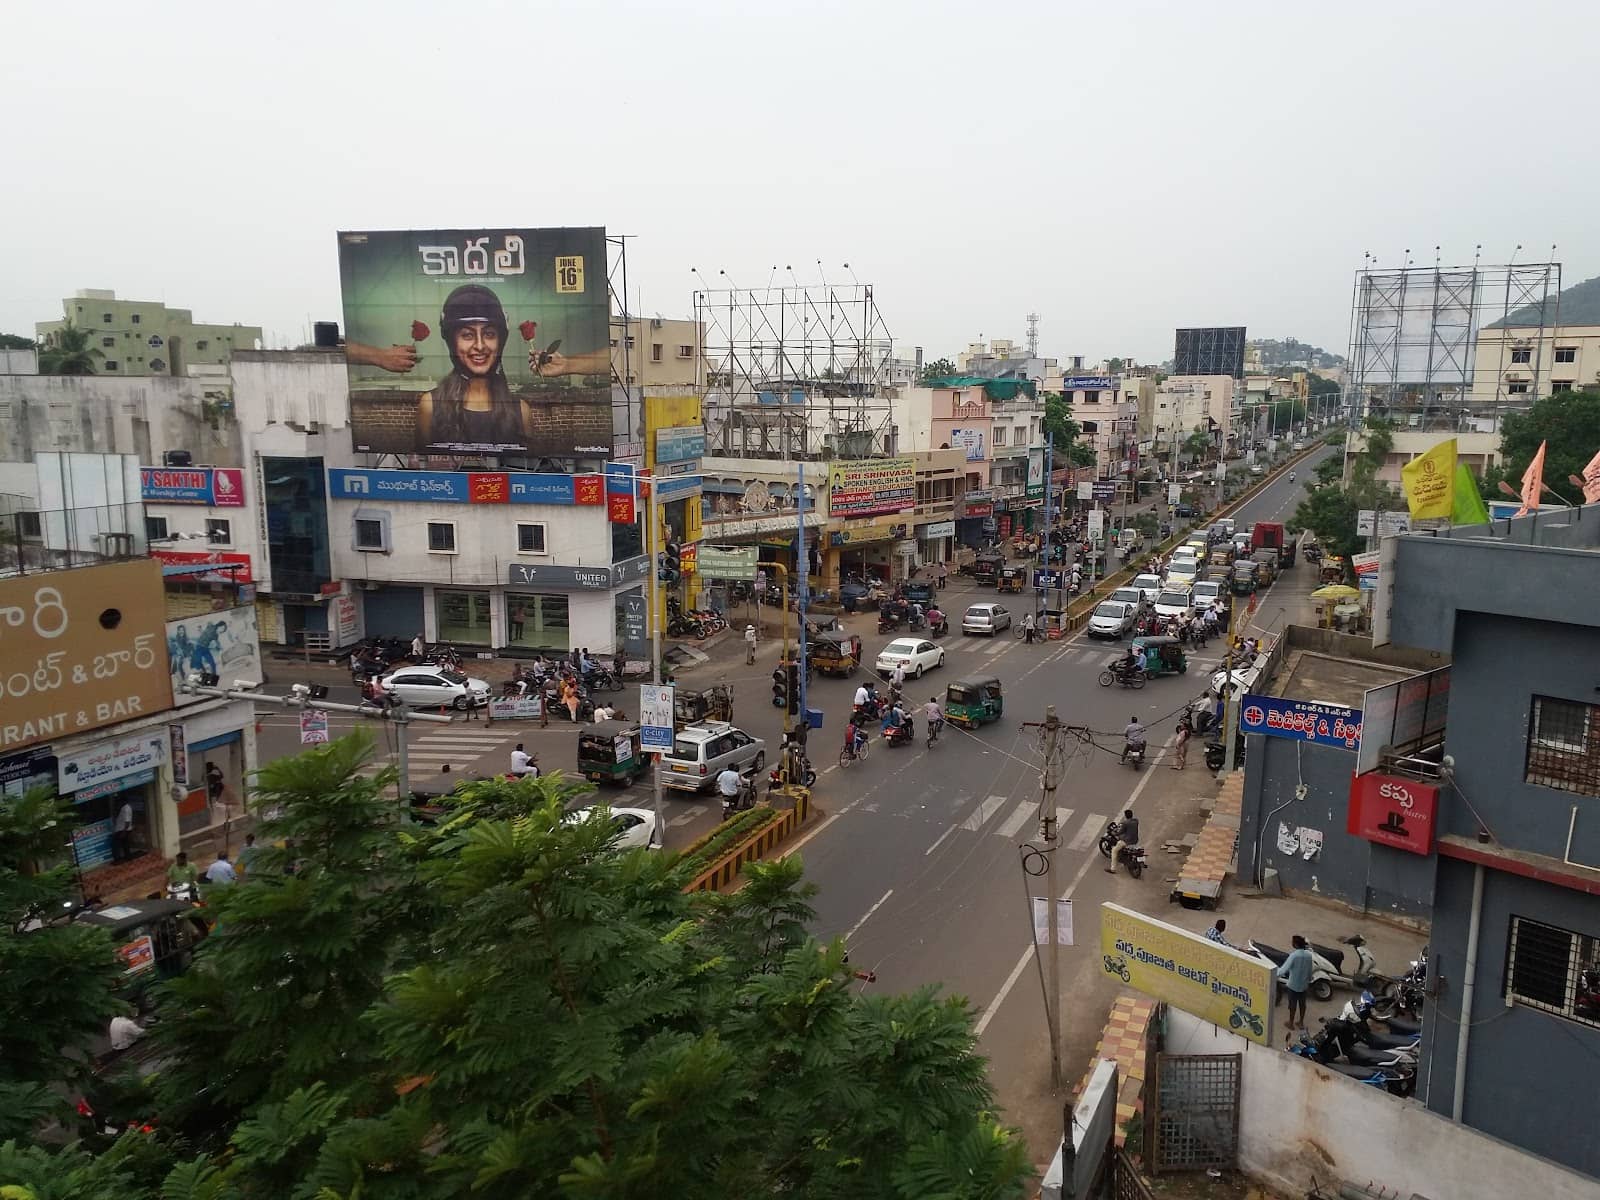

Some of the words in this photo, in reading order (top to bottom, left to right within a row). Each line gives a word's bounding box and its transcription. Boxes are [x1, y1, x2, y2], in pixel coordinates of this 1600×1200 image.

[418, 235, 525, 275] కాదలి
[560, 259, 576, 267] JUNE
[153, 471, 206, 488] SAKTHI
[844, 479, 867, 487] SPOKEN
[869, 477, 893, 486] ENGLISH
[864, 469, 912, 479] SRINIVASA
[879, 482, 914, 491] EDUCATION
[575, 573, 607, 582] UNITED
[72, 664, 88, 684] &
[93, 633, 155, 678] బార్
[0, 713, 67, 745] RANT
[76, 711, 88, 726] &
[96, 696, 142, 721] BAR
[1317, 719, 1330, 736] &
[1178, 965, 1210, 985] ఆటో
